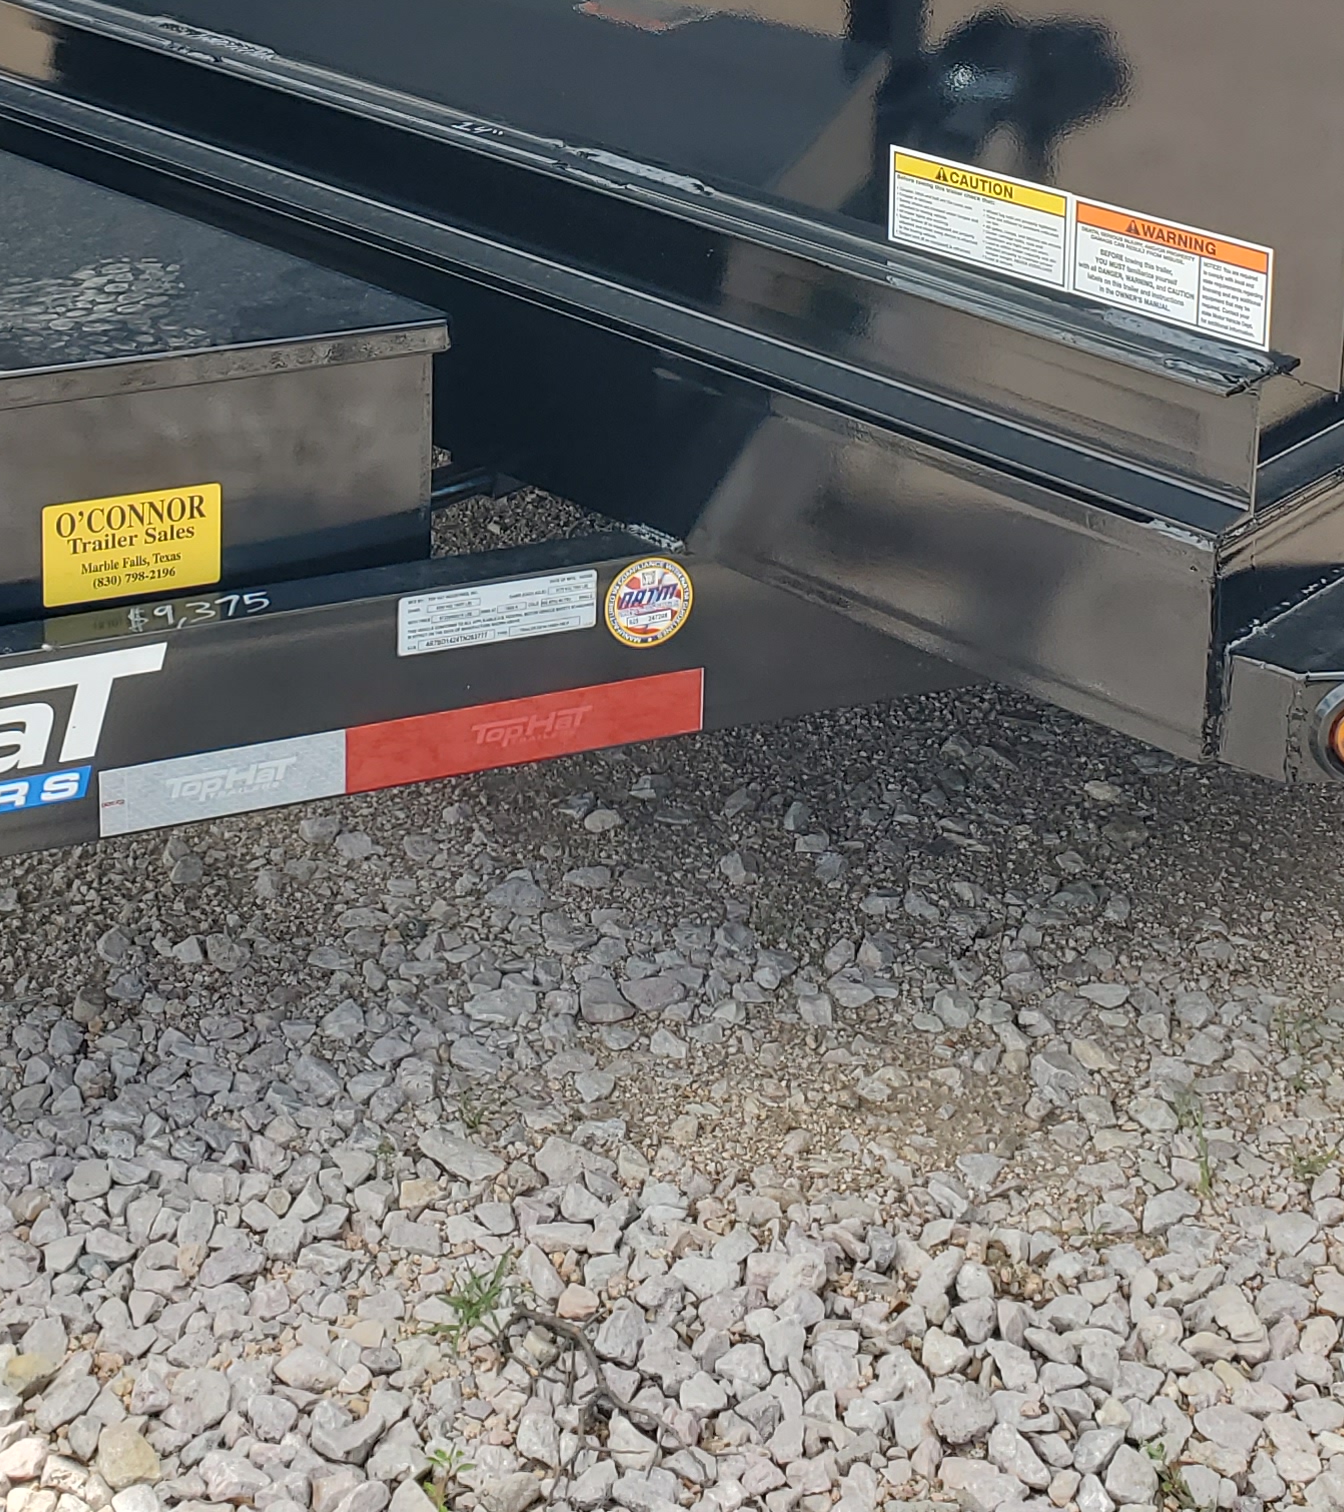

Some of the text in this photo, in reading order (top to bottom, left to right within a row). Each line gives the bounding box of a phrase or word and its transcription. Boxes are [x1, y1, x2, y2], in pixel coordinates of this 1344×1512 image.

[949, 170, 1013, 199] CAUTION
[1141, 223, 1216, 256] WARNING
[56, 494, 206, 538] O'CONNOR
[67, 525, 195, 555] Trailer Sales
[81, 551, 181, 575] Marble Falls, Texas
[93, 566, 176, 589] (830) 798-2196
